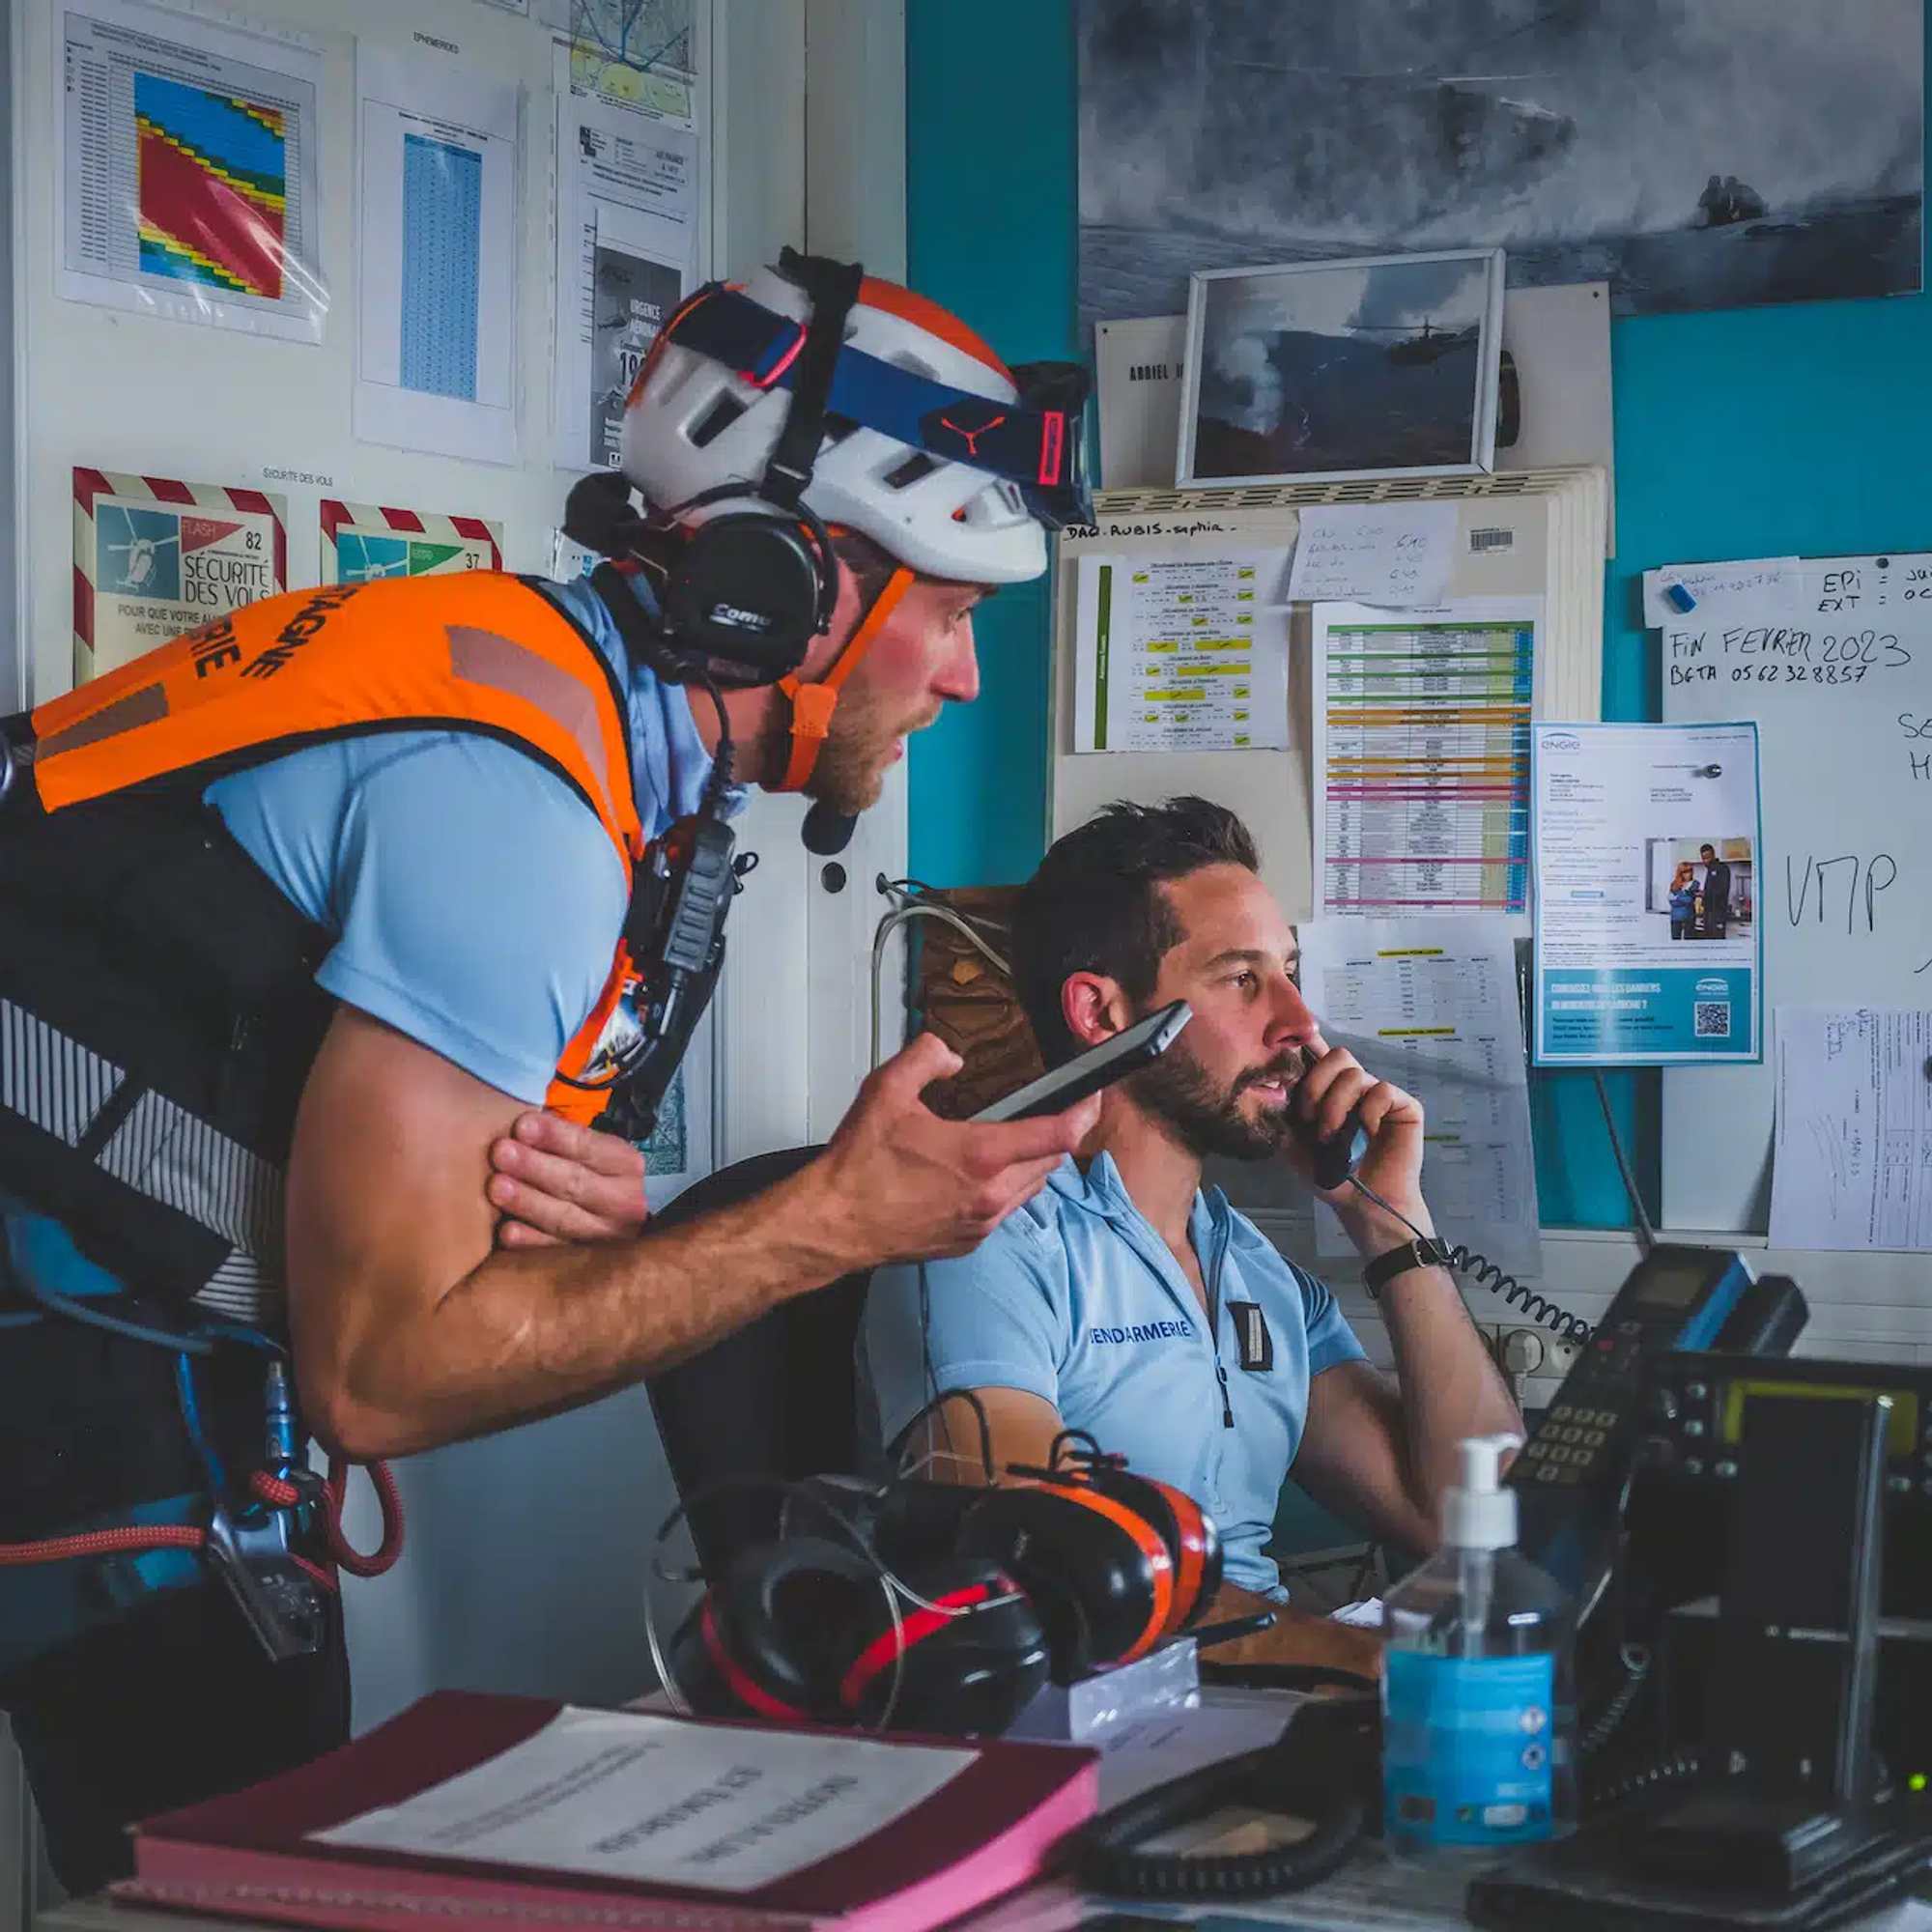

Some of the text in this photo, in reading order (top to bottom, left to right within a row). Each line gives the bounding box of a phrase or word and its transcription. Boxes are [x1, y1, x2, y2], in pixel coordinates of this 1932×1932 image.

[182, 519, 215, 538] FLASH
[245, 531, 262, 551] 82
[185, 552, 270, 587] SÉCURITÉ
[465, 553, 480, 569] 37
[185, 581, 218, 607] DES
[1818, 595, 1861, 612] EXT
[118, 604, 147, 617] POUR
[147, 607, 168, 621] QUE
[169, 610, 201, 624] VOTRE
[133, 622, 160, 636] AVEC
[1823, 629, 1912, 668] 2023
